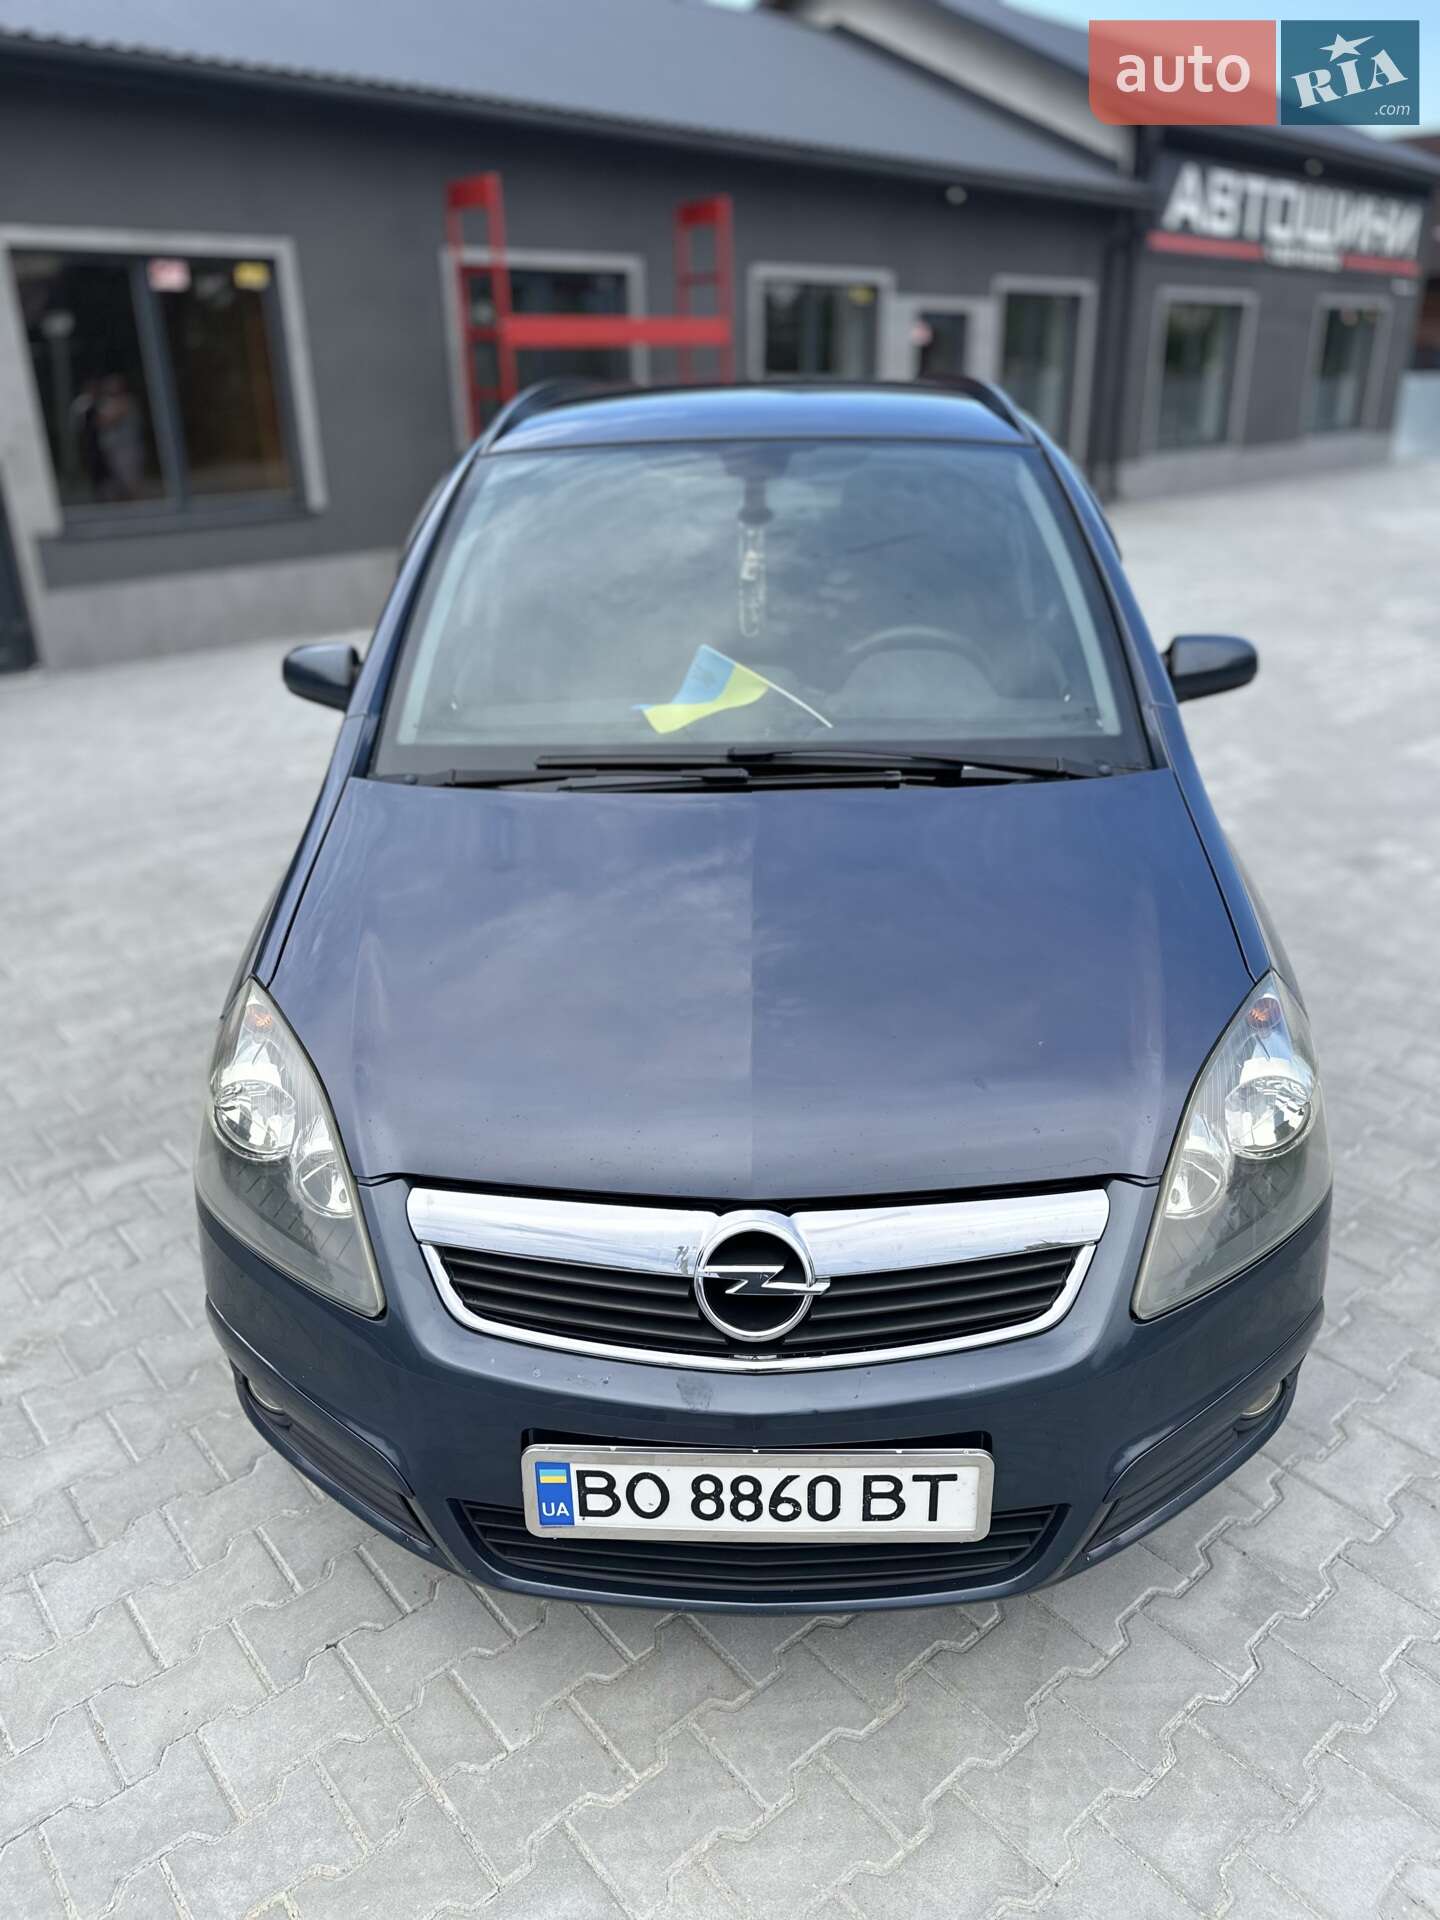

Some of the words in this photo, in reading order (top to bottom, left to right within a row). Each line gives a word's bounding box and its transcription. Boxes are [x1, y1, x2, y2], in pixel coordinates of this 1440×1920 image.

[541, 1502, 570, 1518] UA
[575, 1469, 670, 1520] BO
[690, 1473, 841, 1522] 8860
[861, 1473, 958, 1522] BT
